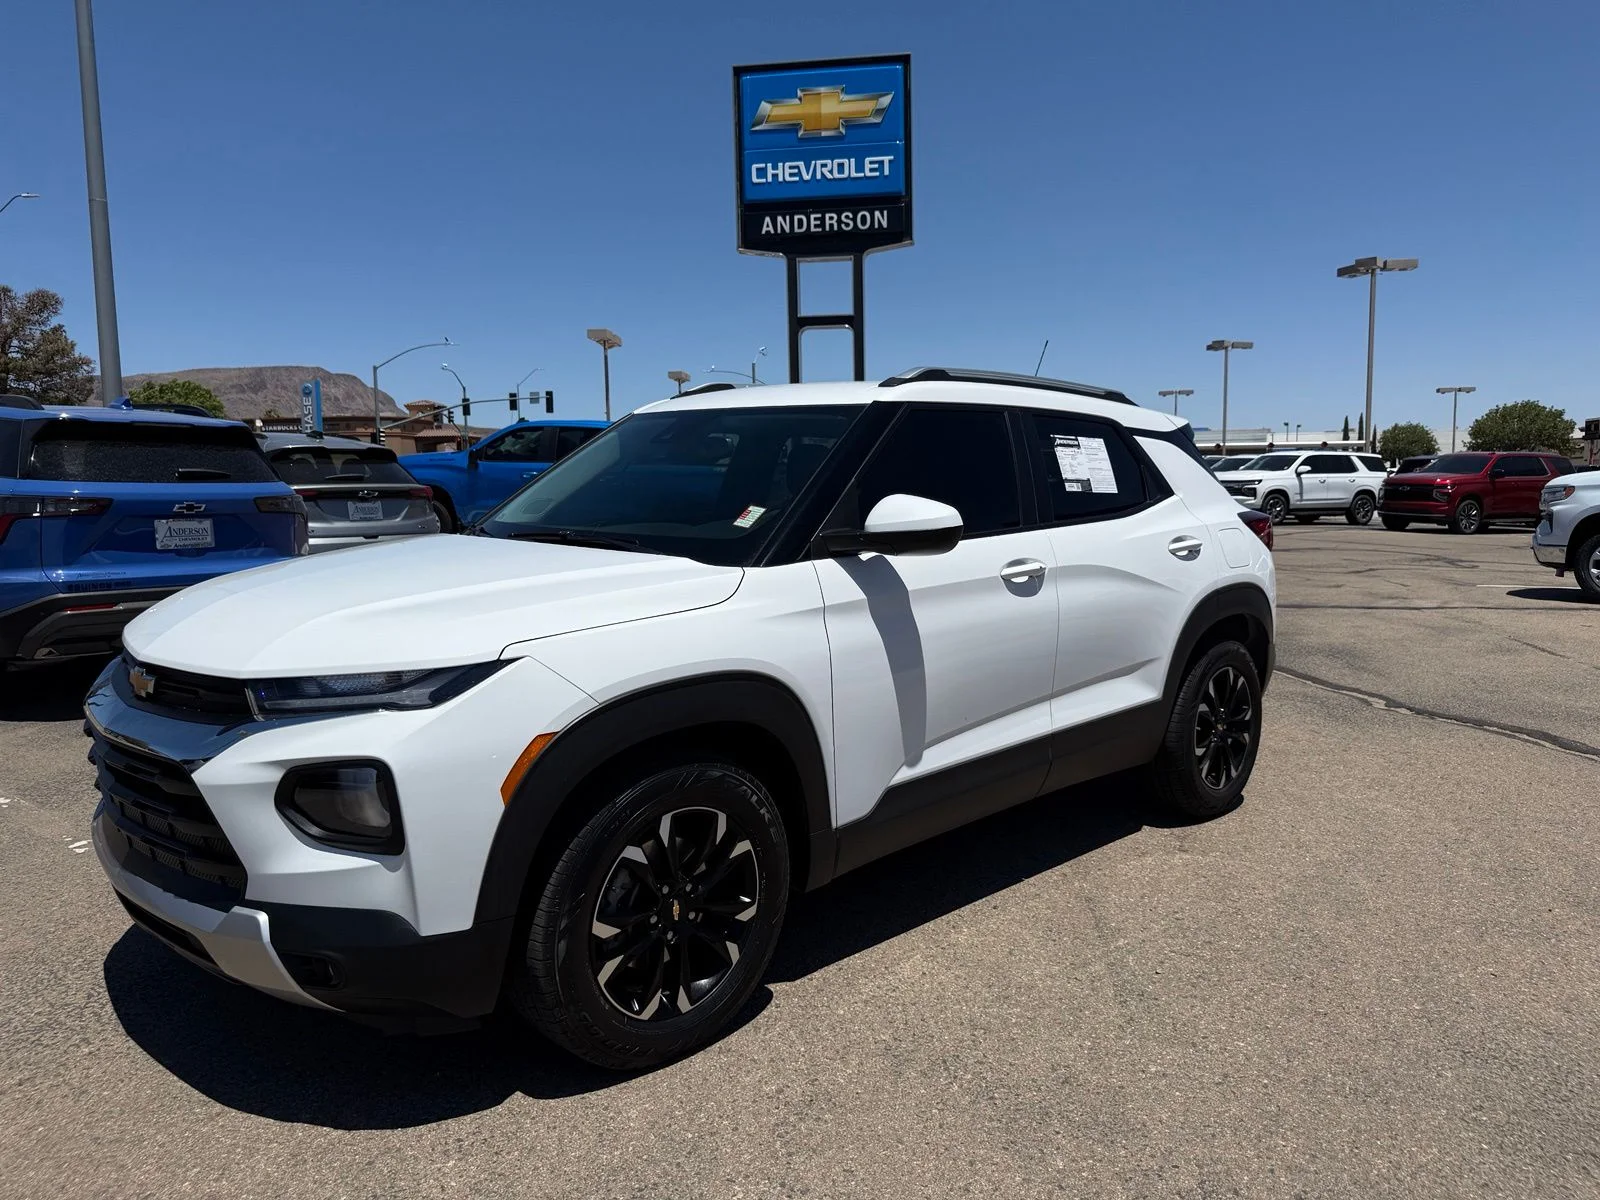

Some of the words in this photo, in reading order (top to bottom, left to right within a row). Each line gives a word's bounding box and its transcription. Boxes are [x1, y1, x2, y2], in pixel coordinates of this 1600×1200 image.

[751, 155, 894, 183] CHEVROLET
[761, 210, 888, 234] ANDERSON
[303, 397, 313, 433] HASE
[160, 526, 209, 542] ANDERSON
